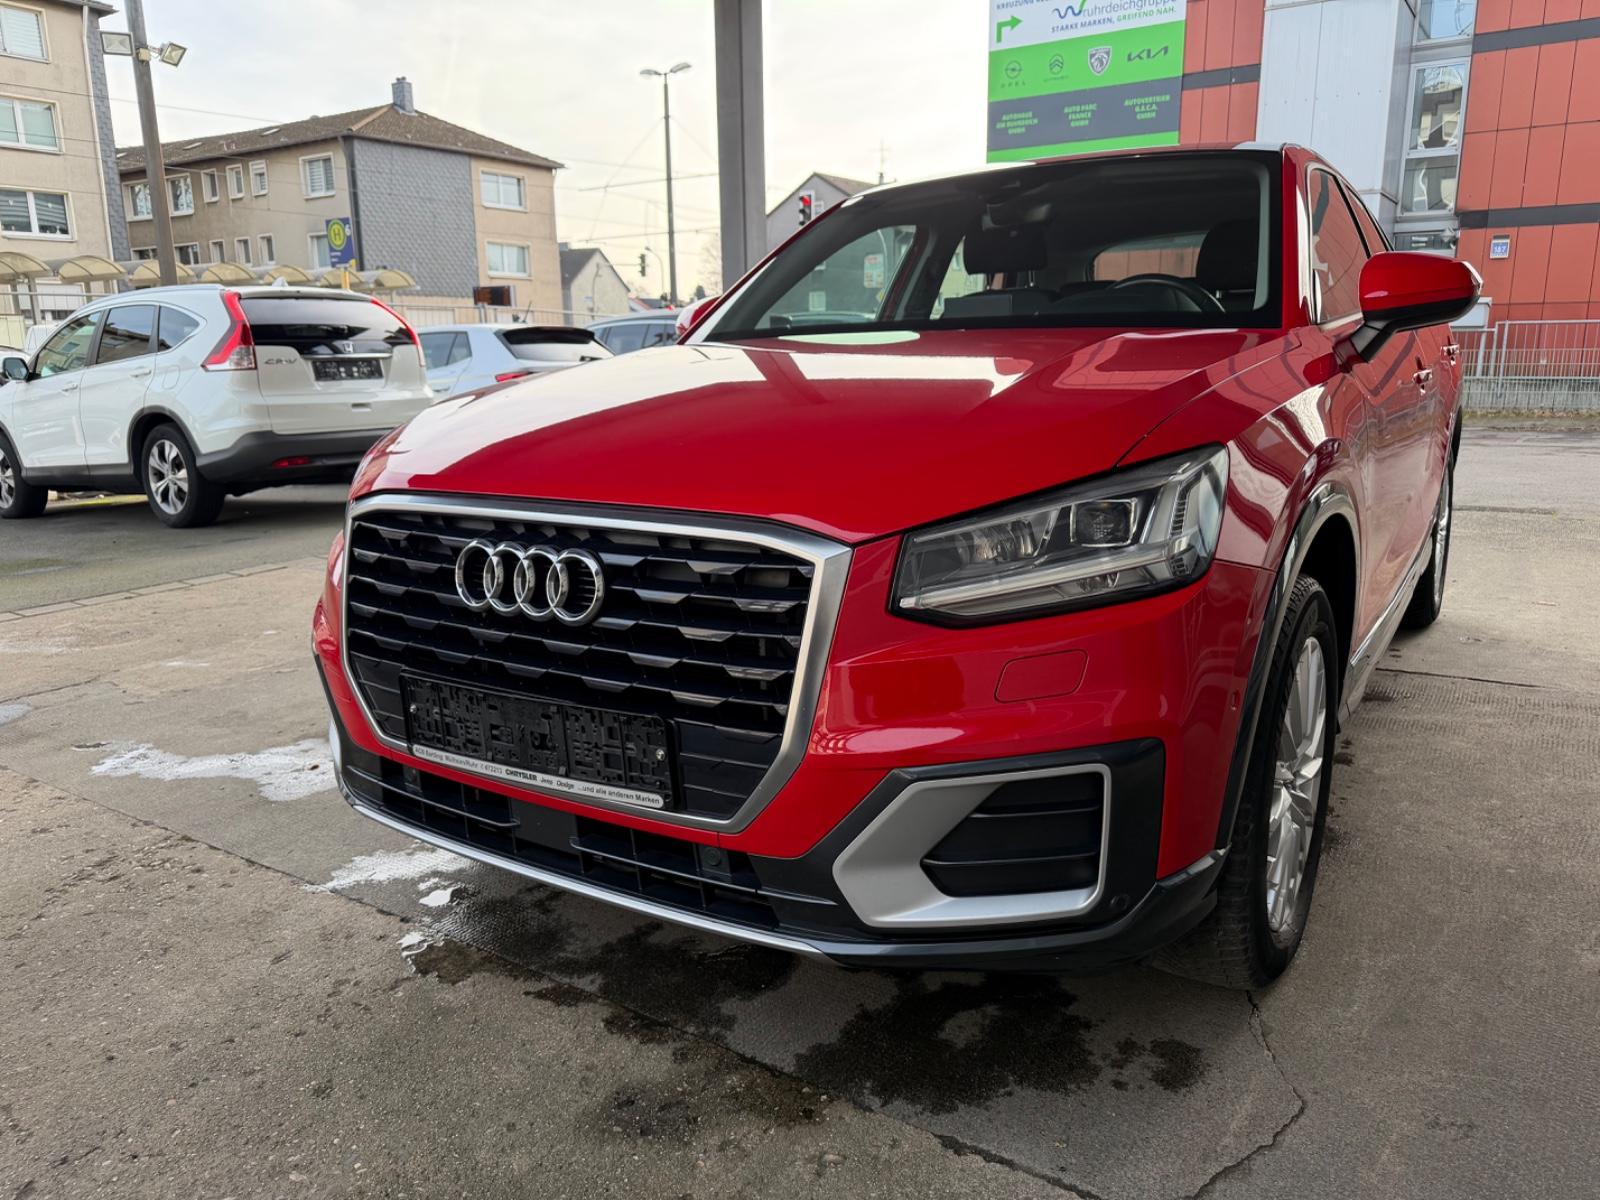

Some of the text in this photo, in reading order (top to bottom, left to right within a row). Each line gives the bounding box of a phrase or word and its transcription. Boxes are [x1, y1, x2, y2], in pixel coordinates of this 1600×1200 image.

[1083, 0, 1177, 17] ruhrdeichgrupp
[1051, 22, 1079, 33] STARKE
[1117, 9, 1154, 22] GREIFEND
[1127, 45, 1168, 62] KIA
[505, 768, 537, 782] CHRYSLER
[556, 779, 575, 790] Dodge
[635, 793, 660, 805] Marken
